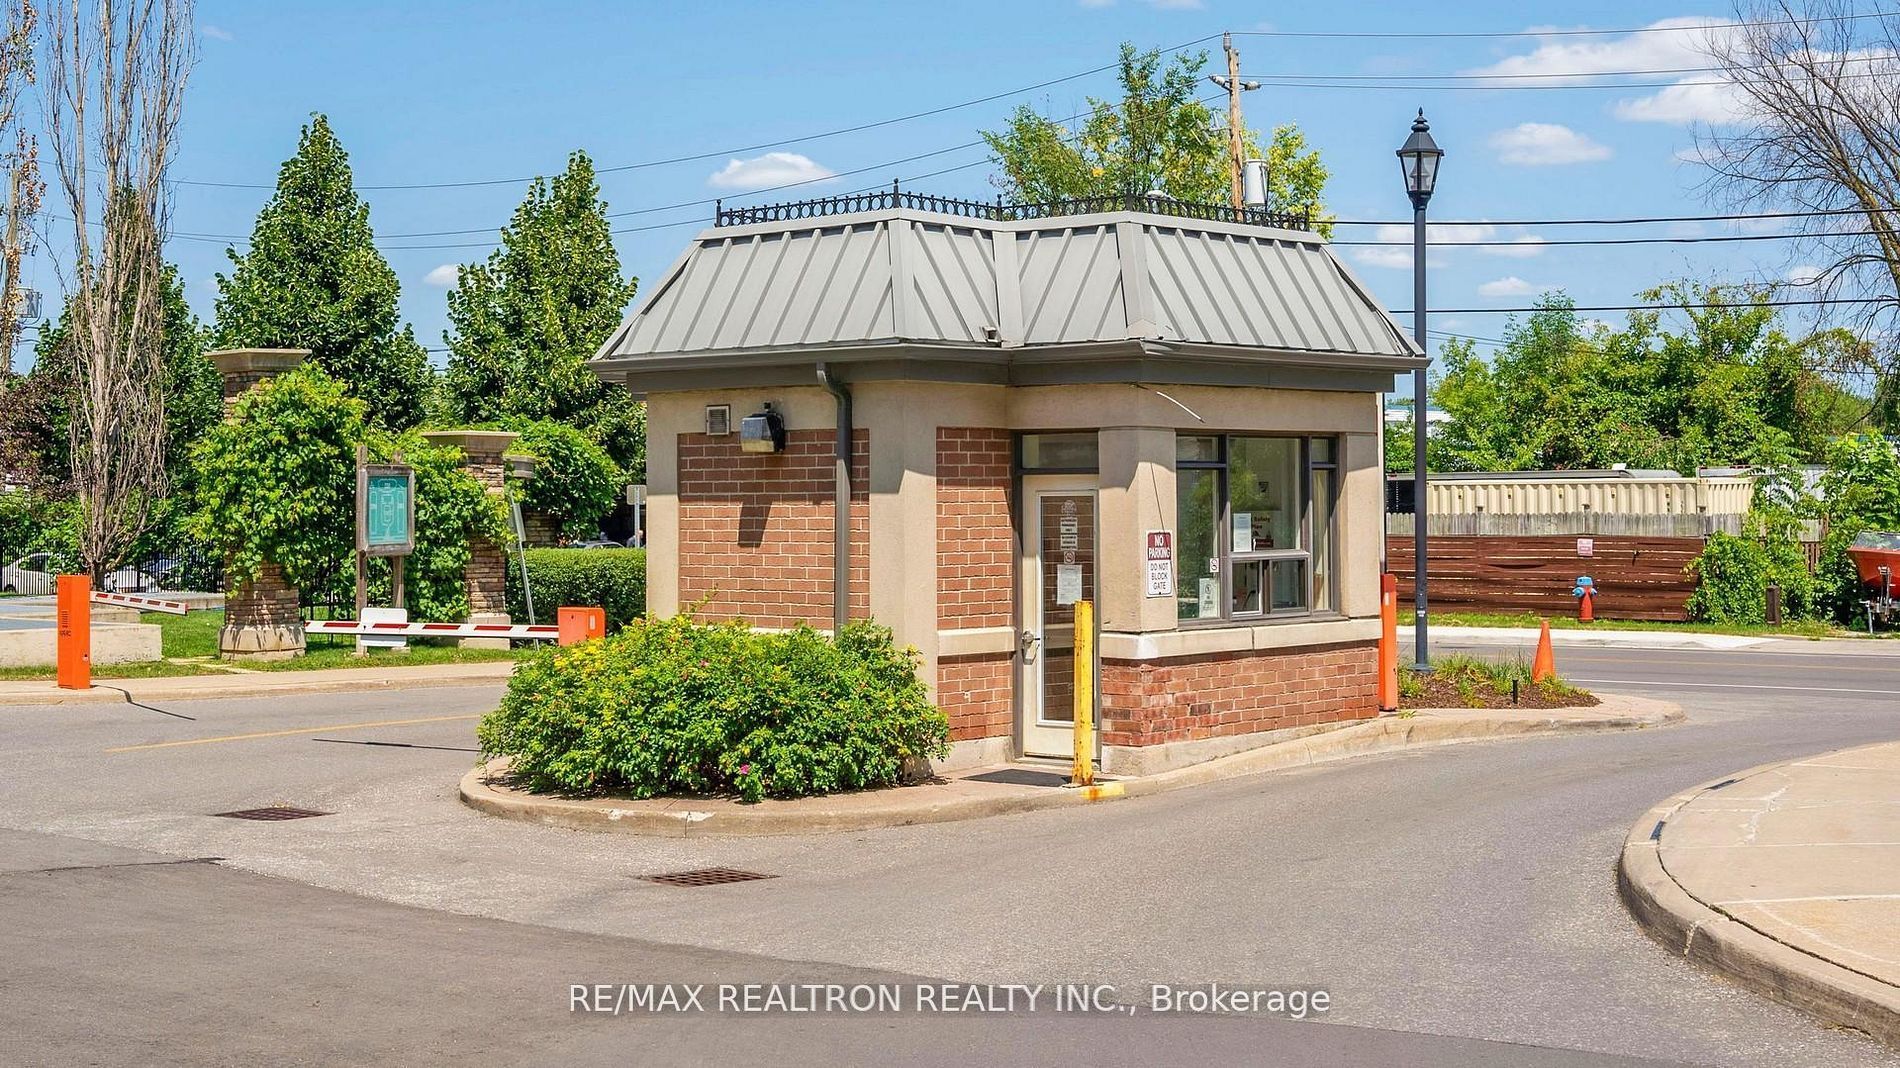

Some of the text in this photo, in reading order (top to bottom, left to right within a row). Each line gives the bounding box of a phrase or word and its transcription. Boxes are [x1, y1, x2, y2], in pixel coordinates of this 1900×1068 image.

[1154, 534, 1164, 547] NO
[1148, 547, 1171, 559] PARKING
[1150, 562, 1169, 571] DO NOT
[1151, 572, 1168, 581] BLOCK
[1153, 581, 1166, 590] GATE
